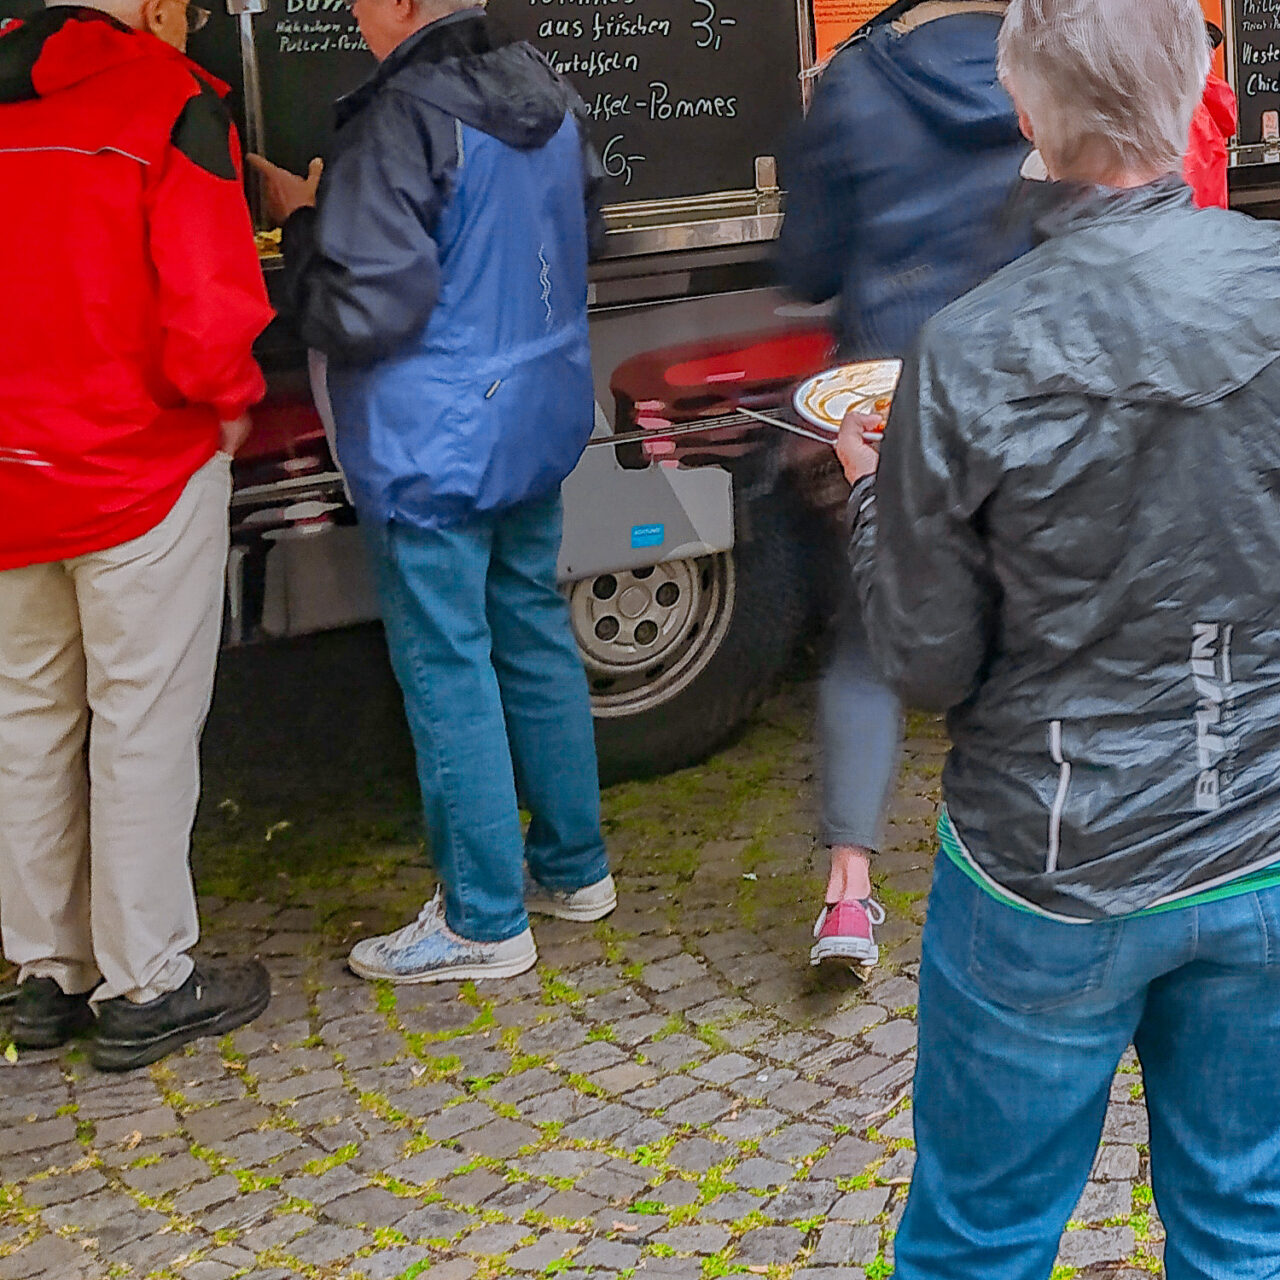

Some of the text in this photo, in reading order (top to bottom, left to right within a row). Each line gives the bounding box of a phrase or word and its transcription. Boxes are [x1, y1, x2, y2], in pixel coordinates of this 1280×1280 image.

[538, 13, 671, 41] aus frischen
[602, 134, 646, 186] 6,-
